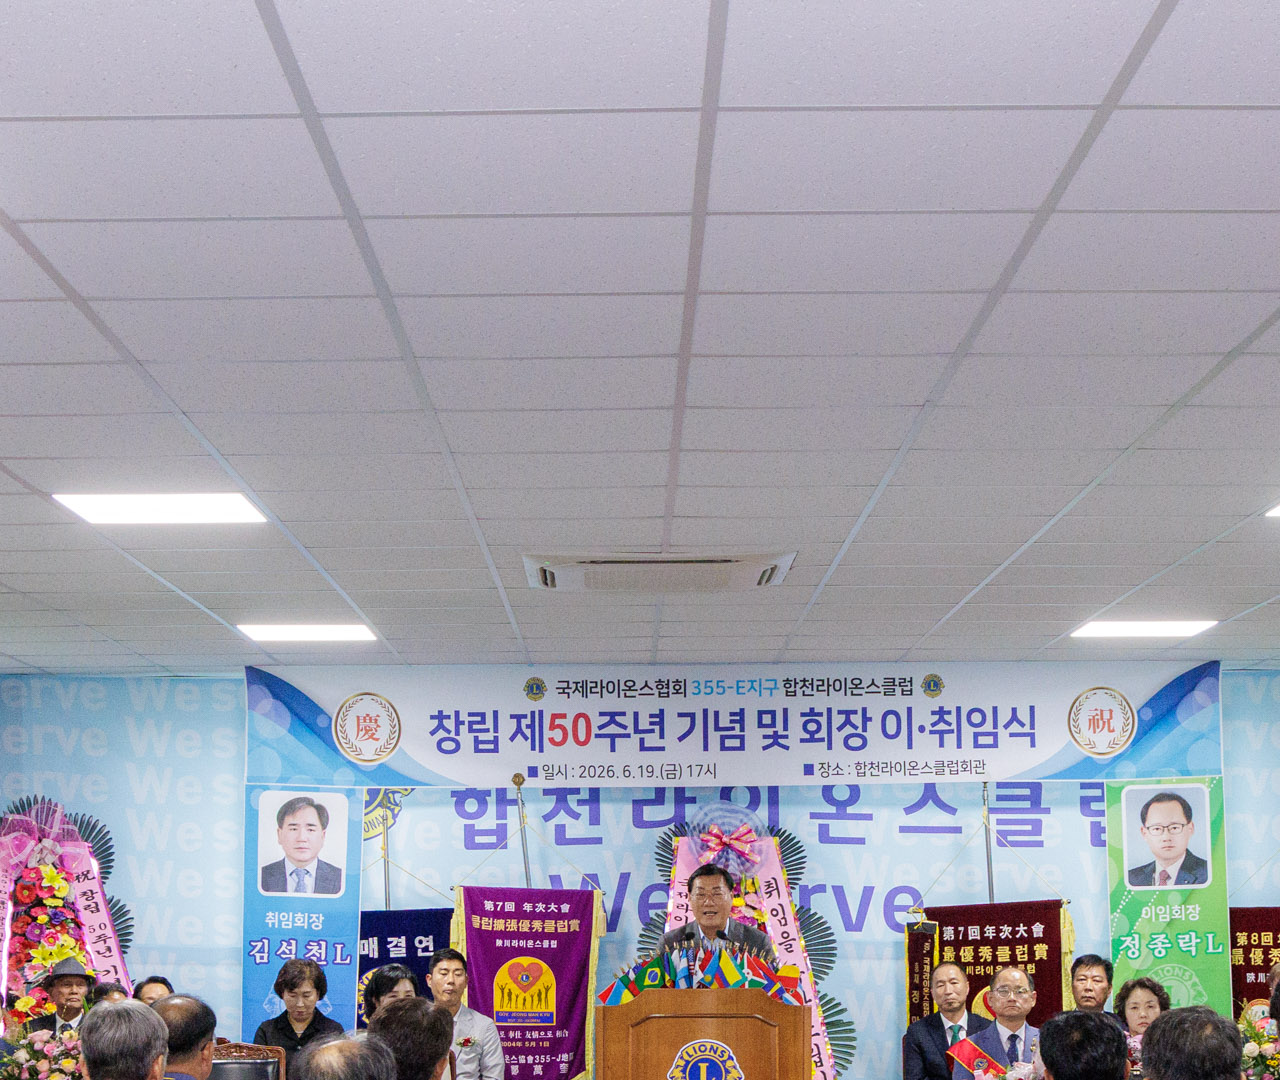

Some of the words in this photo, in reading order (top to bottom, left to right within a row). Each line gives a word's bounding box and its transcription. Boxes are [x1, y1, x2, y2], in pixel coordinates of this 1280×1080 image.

[125, 676, 201, 712] We
[555, 679, 687, 699] 국제라이온스협회
[691, 678, 779, 697] 355-E지구
[782, 677, 913, 697] 합천라이온스클럽
[355, 714, 381, 743] 慶
[428, 709, 500, 755] 창립
[508, 709, 666, 754] 제50주년
[677, 707, 746, 752] 기념
[756, 707, 791, 751] 및
[799, 706, 873, 750] 회장
[1087, 707, 1116, 735] 祝
[125, 715, 203, 758] We
[126, 761, 204, 805] We
[687, 763, 717, 780] 17시
[855, 760, 986, 777] 합천라이온스클럽회관
[126, 807, 204, 851] We
[126, 854, 204, 899] We
[79, 889, 101, 914] 창립
[484, 900, 515, 912] 第7回
[522, 903, 571, 913] 年次大會
[763, 877, 798, 953] 취임을
[1141, 904, 1201, 922] 이임회장
[128, 903, 205, 947] We
[265, 912, 324, 930] 취임회장
[88, 923, 114, 958] 50주년
[685, 1044, 726, 1058] LIONS
